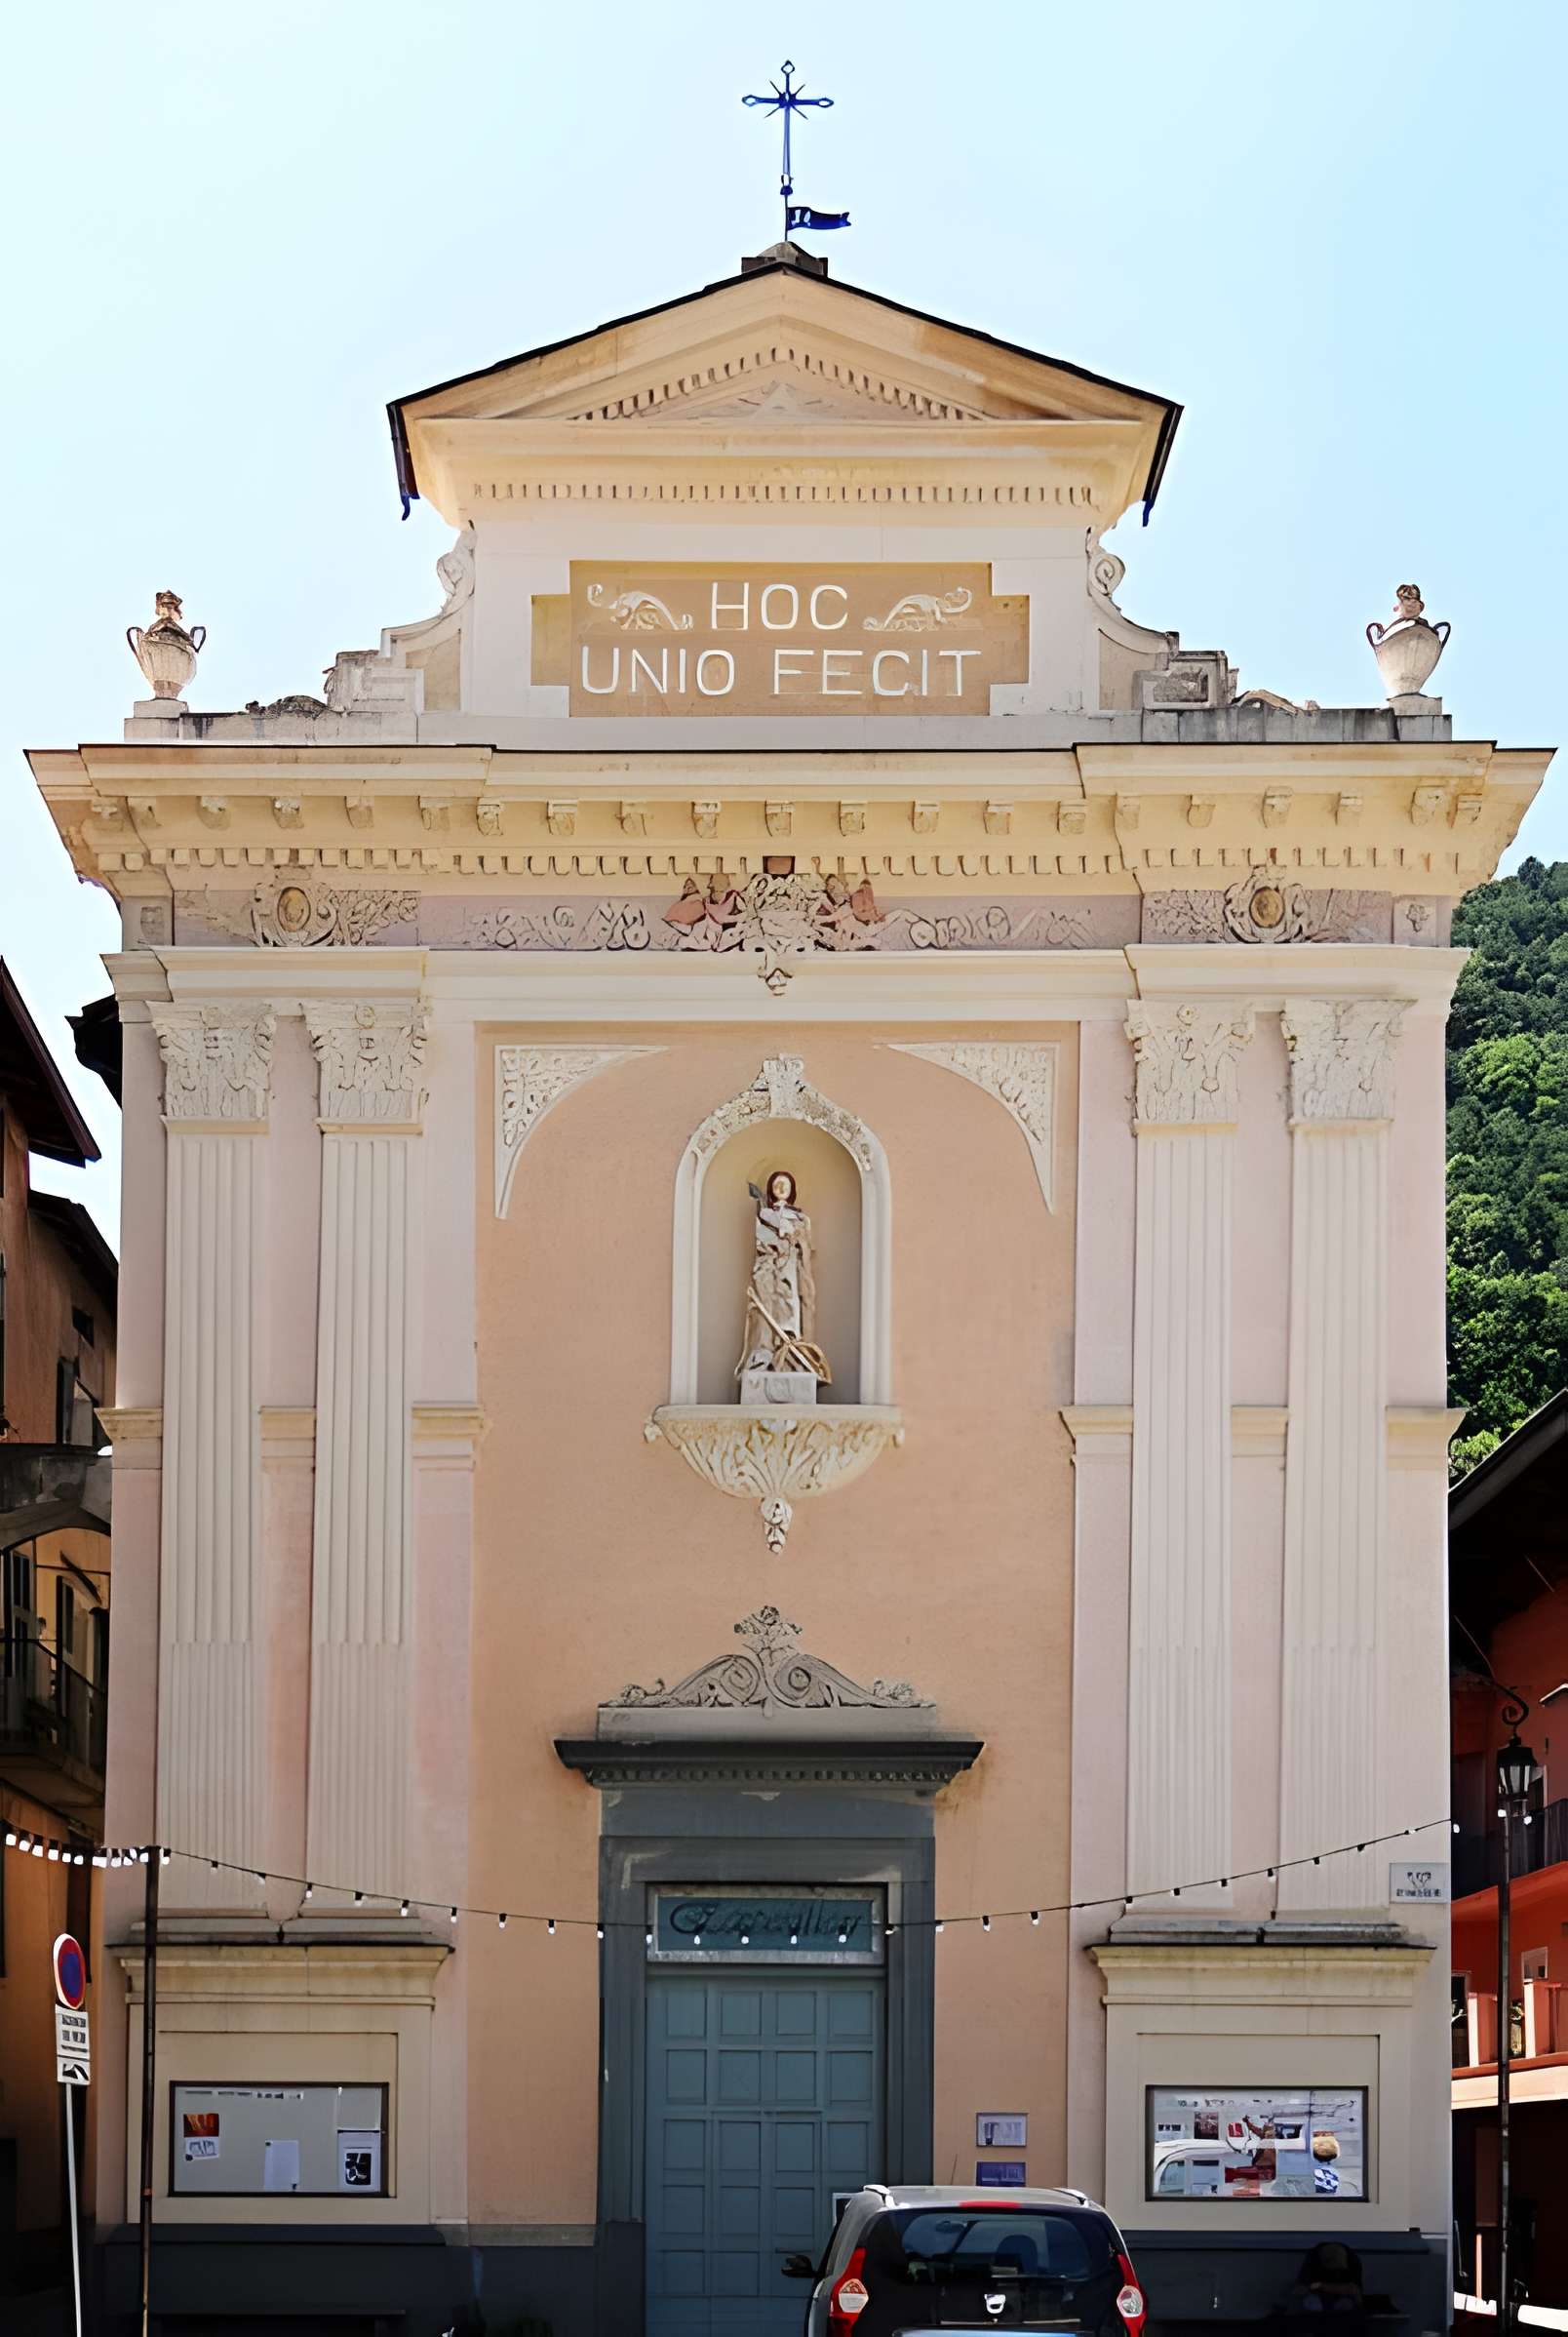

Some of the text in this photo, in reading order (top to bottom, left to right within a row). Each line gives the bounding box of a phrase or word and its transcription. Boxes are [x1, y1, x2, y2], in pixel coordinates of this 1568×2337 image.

[711, 582, 848, 631] HOC
[582, 645, 982, 696] UNIO FECIT
